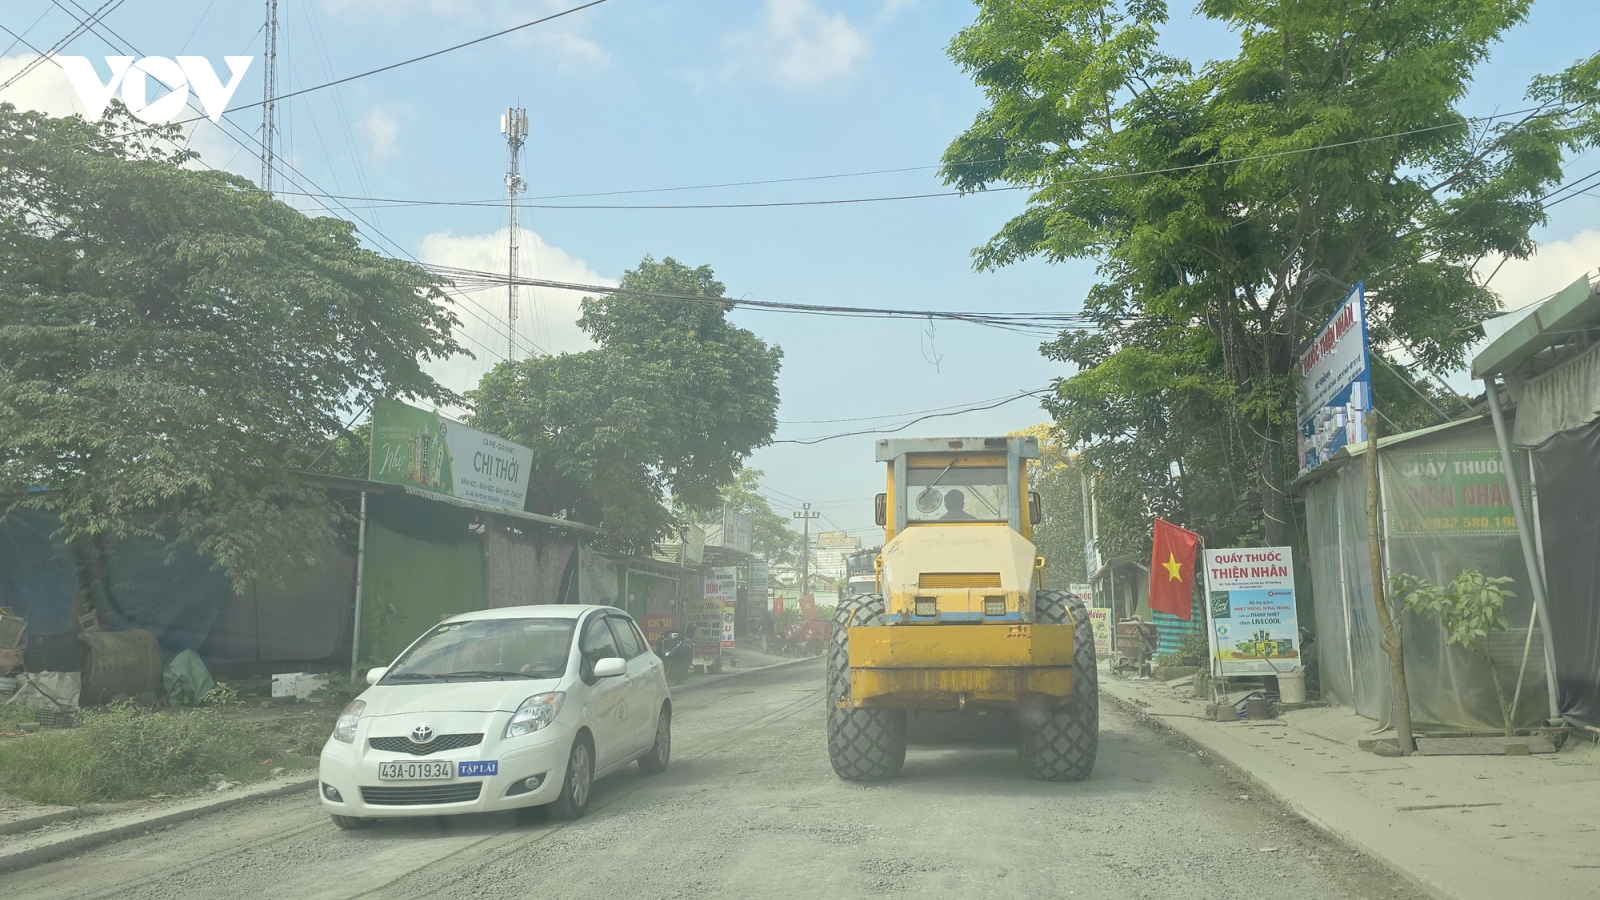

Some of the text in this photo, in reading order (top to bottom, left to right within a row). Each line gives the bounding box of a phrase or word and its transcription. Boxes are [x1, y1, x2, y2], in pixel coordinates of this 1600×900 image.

[474, 451, 494, 481] CHỊ
[1245, 550, 1282, 562] THUỐC
[1211, 564, 1288, 582] THIỆN NHÂN
[706, 581, 718, 594] BÚN
[381, 763, 449, 778] 43A-019.34
